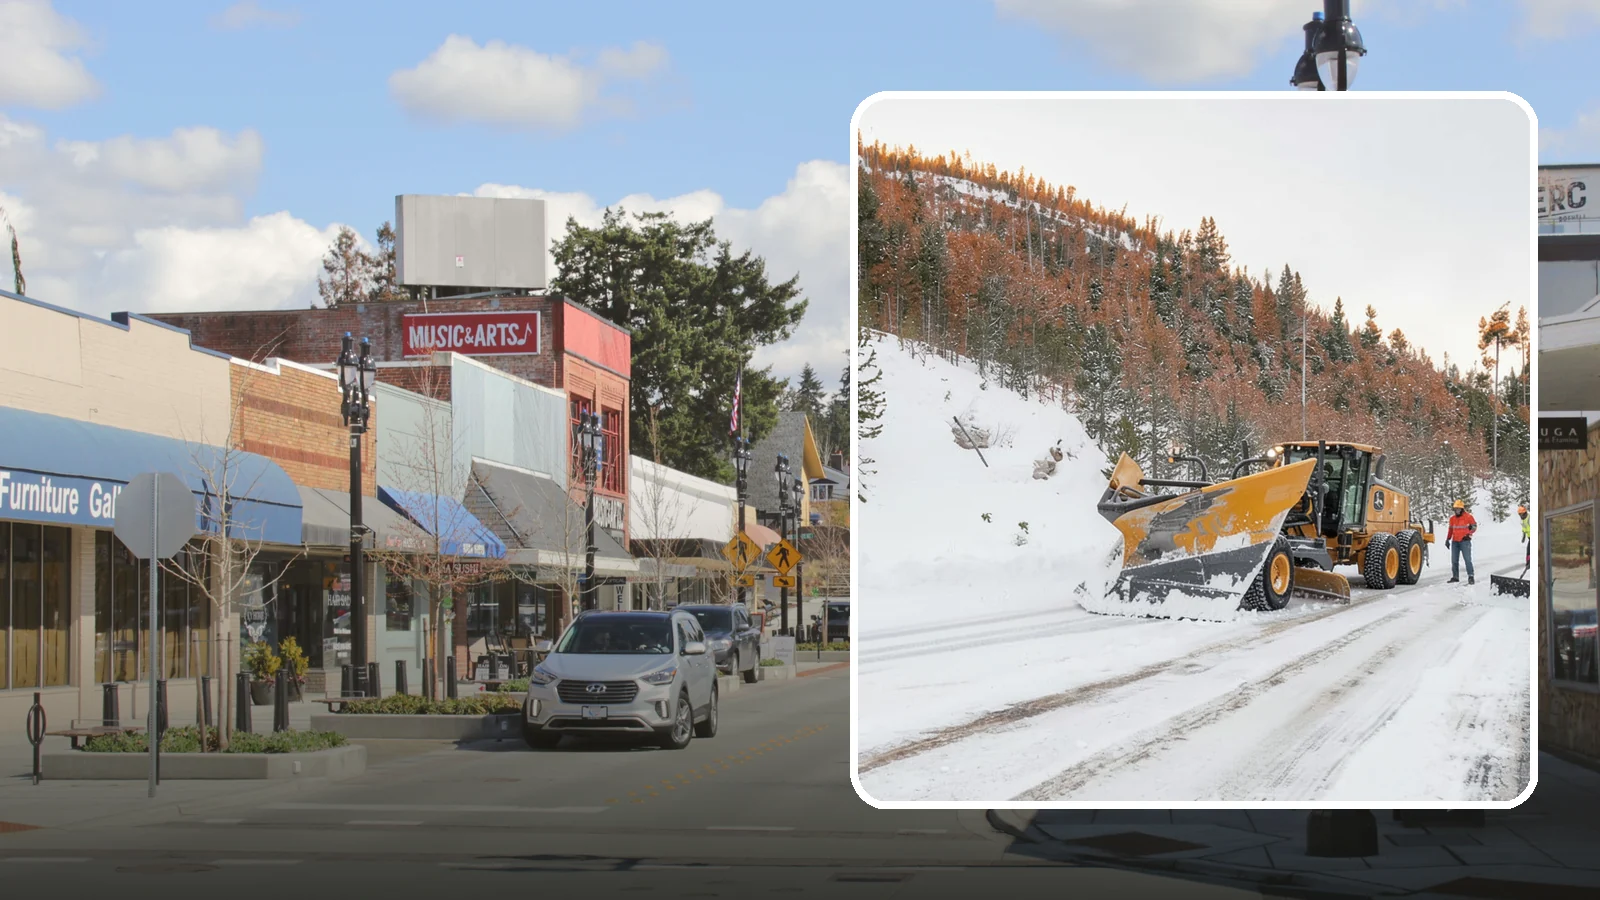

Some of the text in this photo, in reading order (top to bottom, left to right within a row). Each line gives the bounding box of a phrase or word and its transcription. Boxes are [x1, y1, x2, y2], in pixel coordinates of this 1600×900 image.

[0, 471, 121, 519] Furniture Gal
[453, 563, 479, 574] SUSHI
